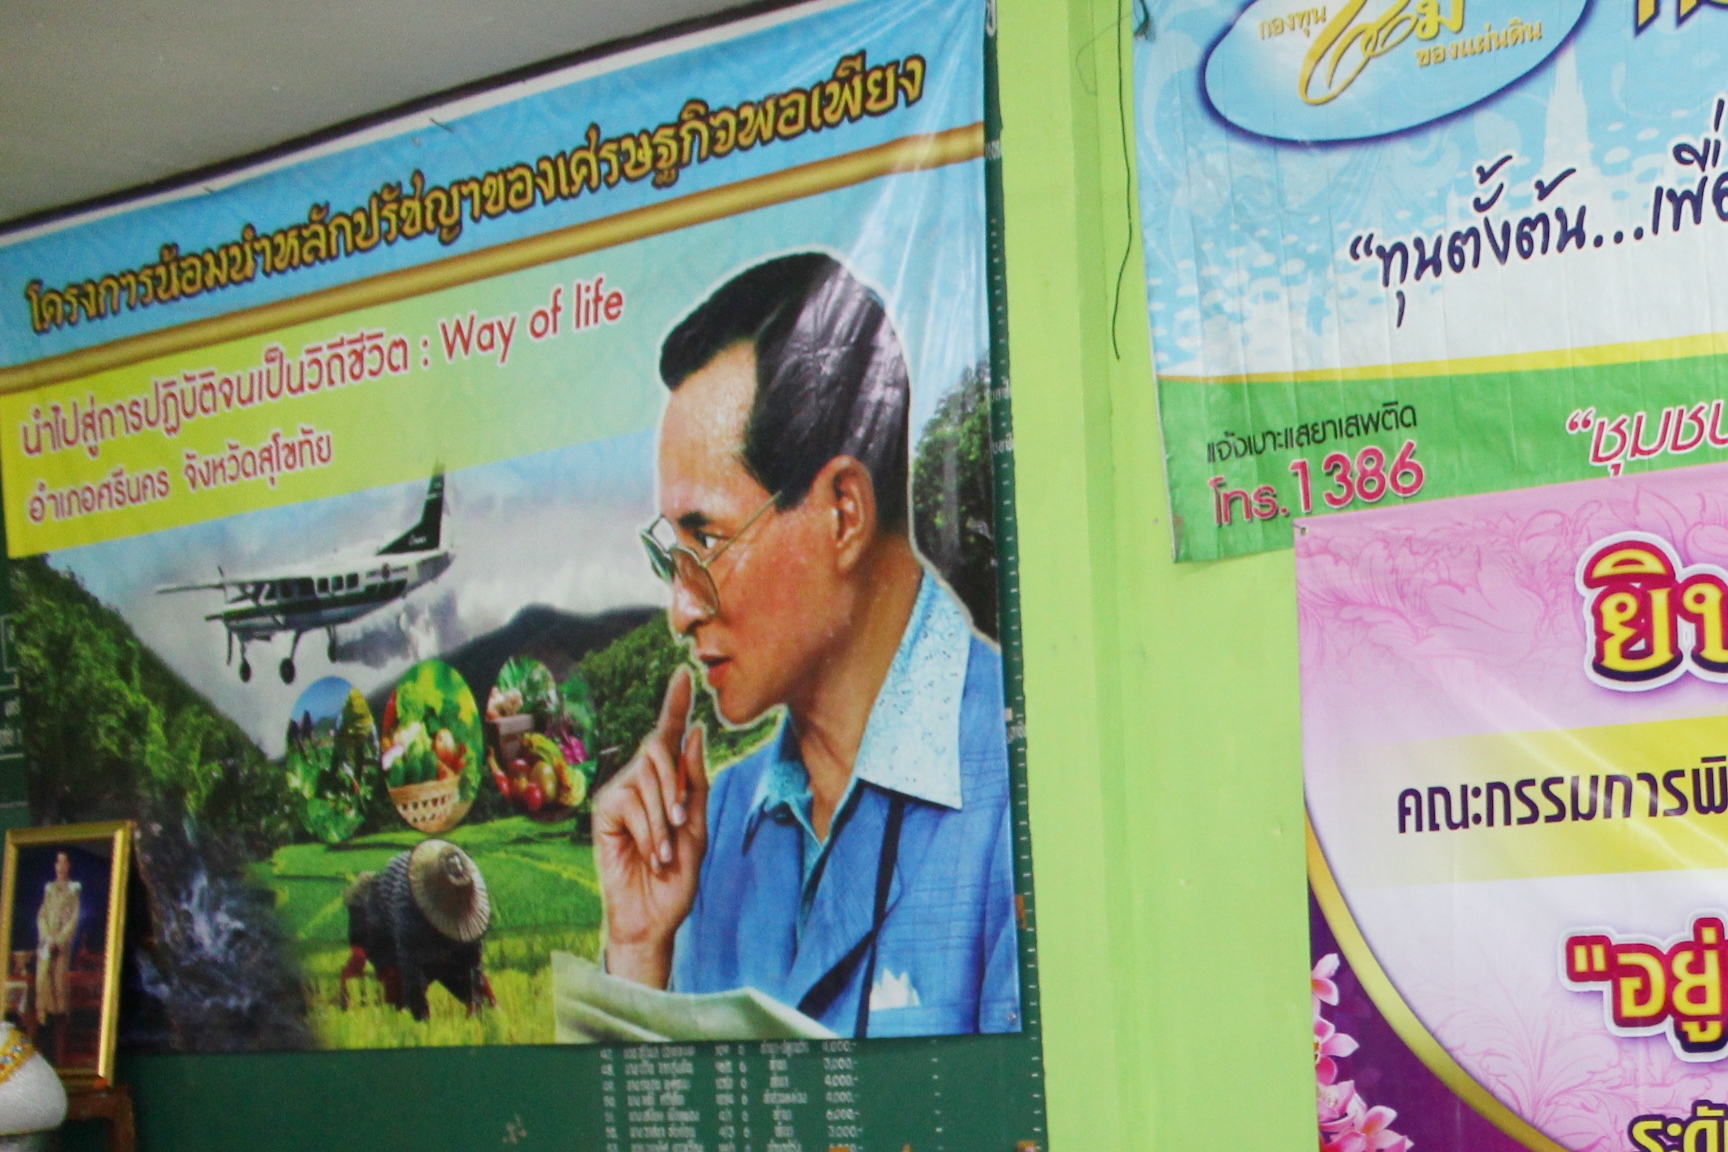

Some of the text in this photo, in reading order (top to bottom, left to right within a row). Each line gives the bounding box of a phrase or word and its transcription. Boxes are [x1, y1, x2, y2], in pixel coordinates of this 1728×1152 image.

[1257, 4, 1327, 41] กองทุน
[1414, 16, 1544, 67] ของแผ่นดิน
[441, 308, 517, 368] Way
[529, 294, 563, 341] of
[573, 277, 626, 330] life
[1206, 402, 1418, 464] แจ้งเบาะแสยาเสพติด
[28, 432, 332, 526] อำเภอศรีนคร จังหวัดสุโขทัย
